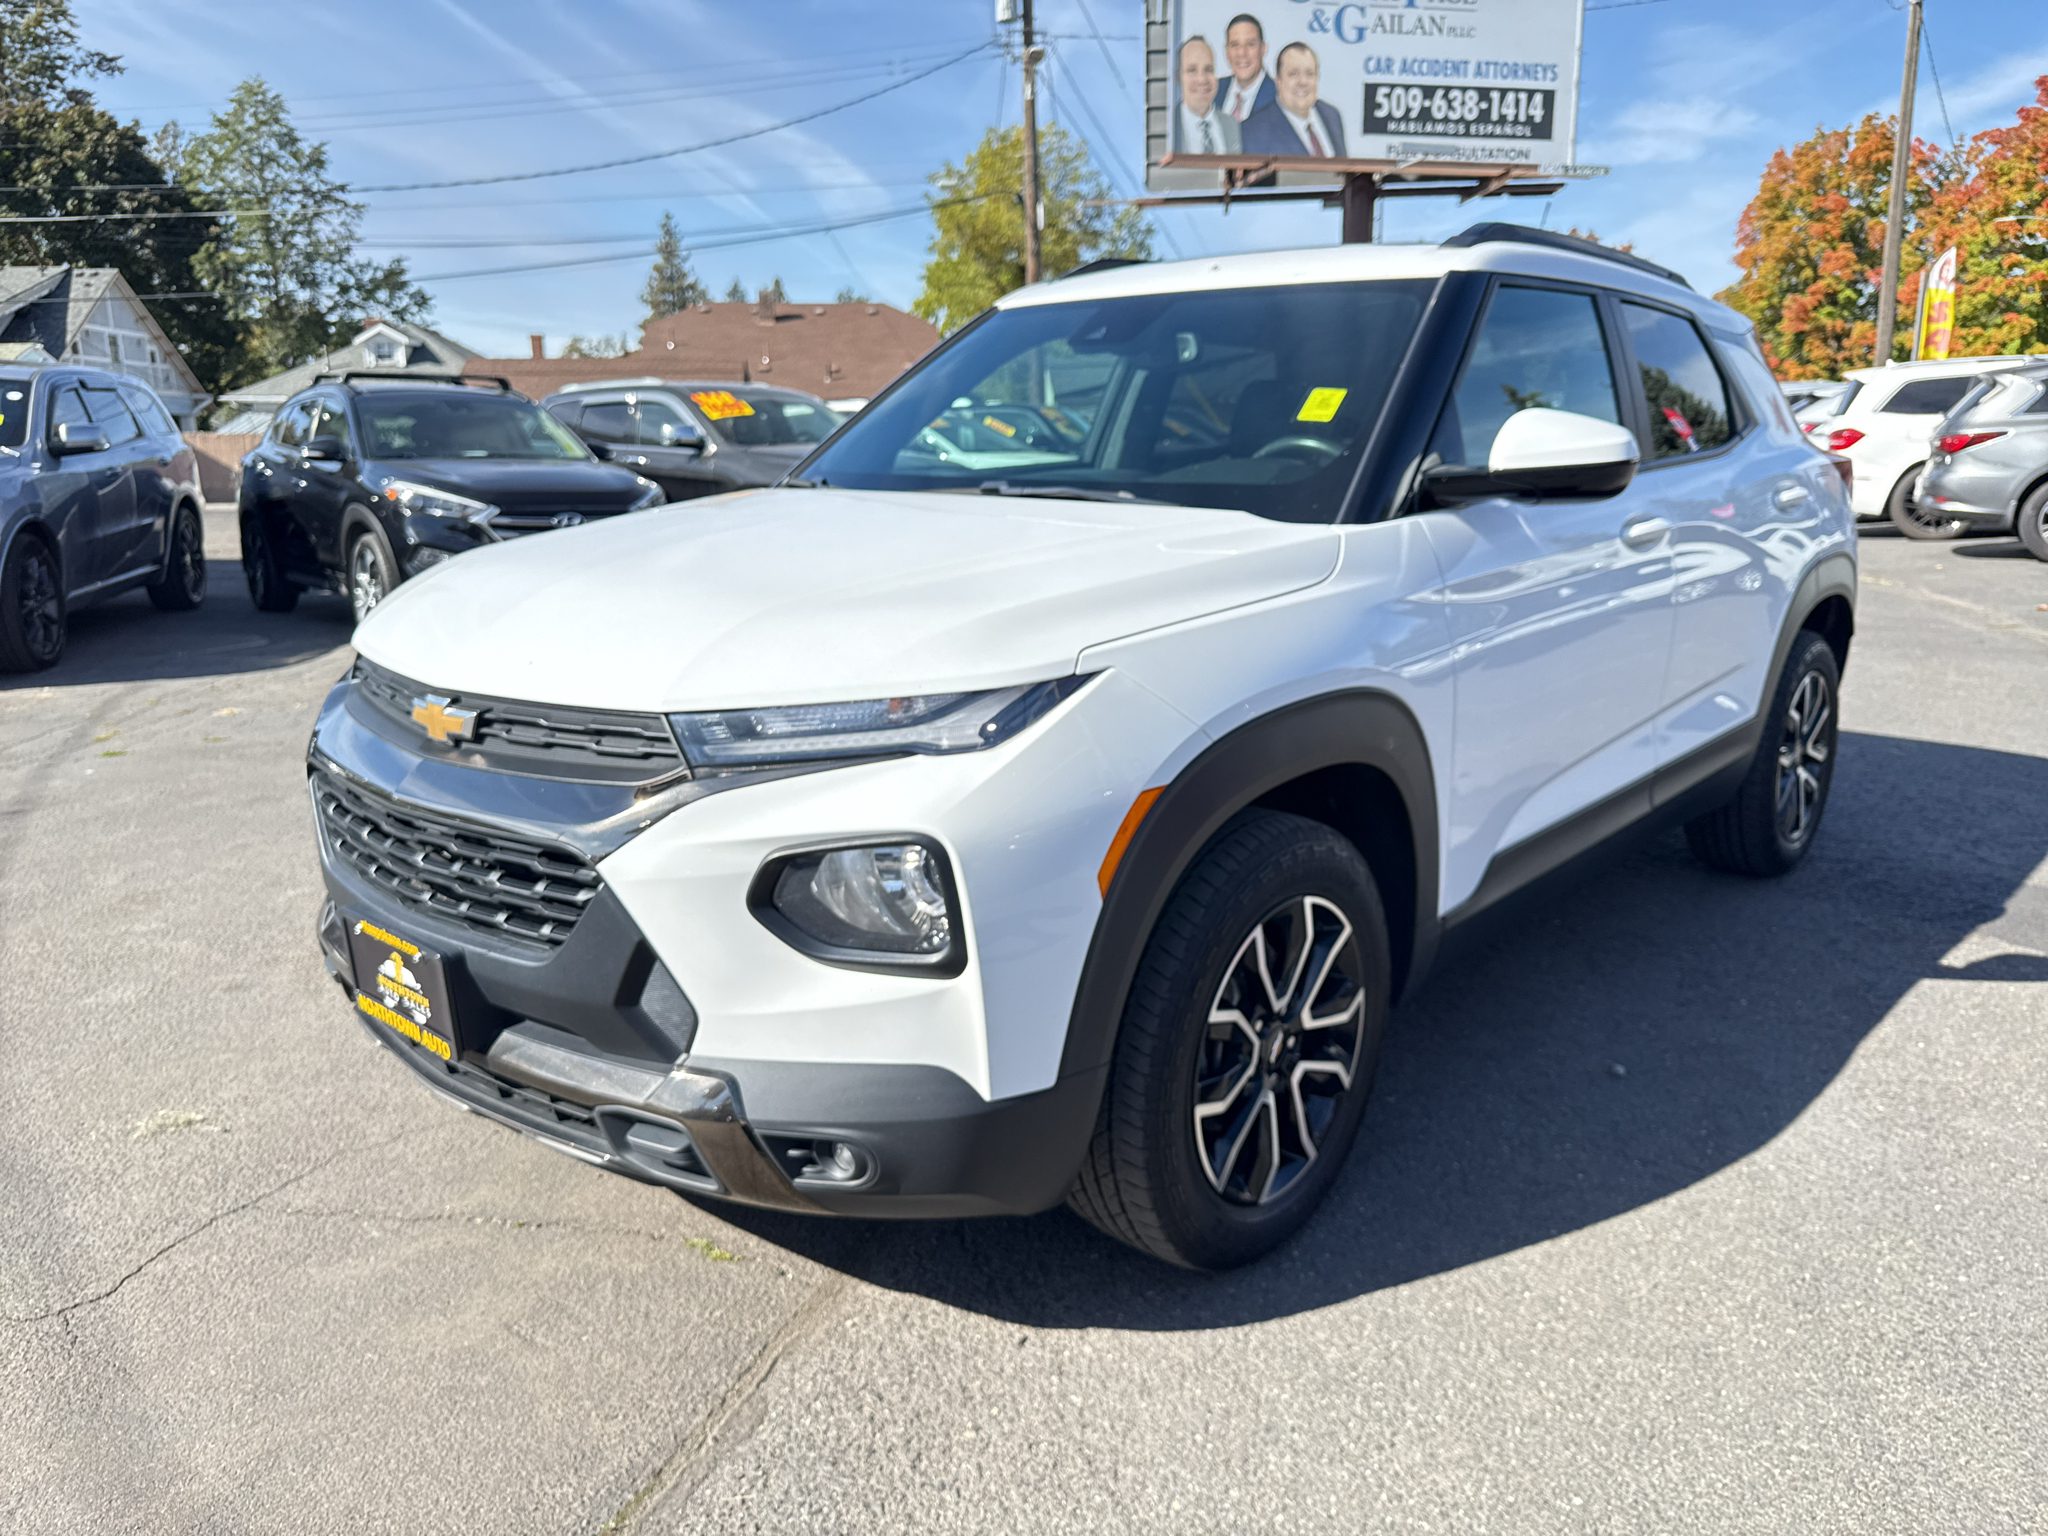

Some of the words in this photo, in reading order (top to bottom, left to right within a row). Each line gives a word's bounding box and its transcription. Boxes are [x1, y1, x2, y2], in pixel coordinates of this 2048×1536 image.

[1308, 9, 1331, 33] &
[1334, 4, 1447, 44] GAILAN
[1364, 56, 1394, 75] CAR
[1399, 57, 1470, 78] ACCIDENT
[1474, 61, 1559, 82] ATTORNEYS
[1373, 86, 1545, 123] 509-638-1414
[1387, 120, 1466, 135] HABLAMOS
[1470, 122, 1533, 137] ESPAÑOL
[376, 973, 430, 1008] NORTHTOWN
[357, 992, 421, 1042] NORTHTOWN
[420, 1029, 451, 1060] AUTO
